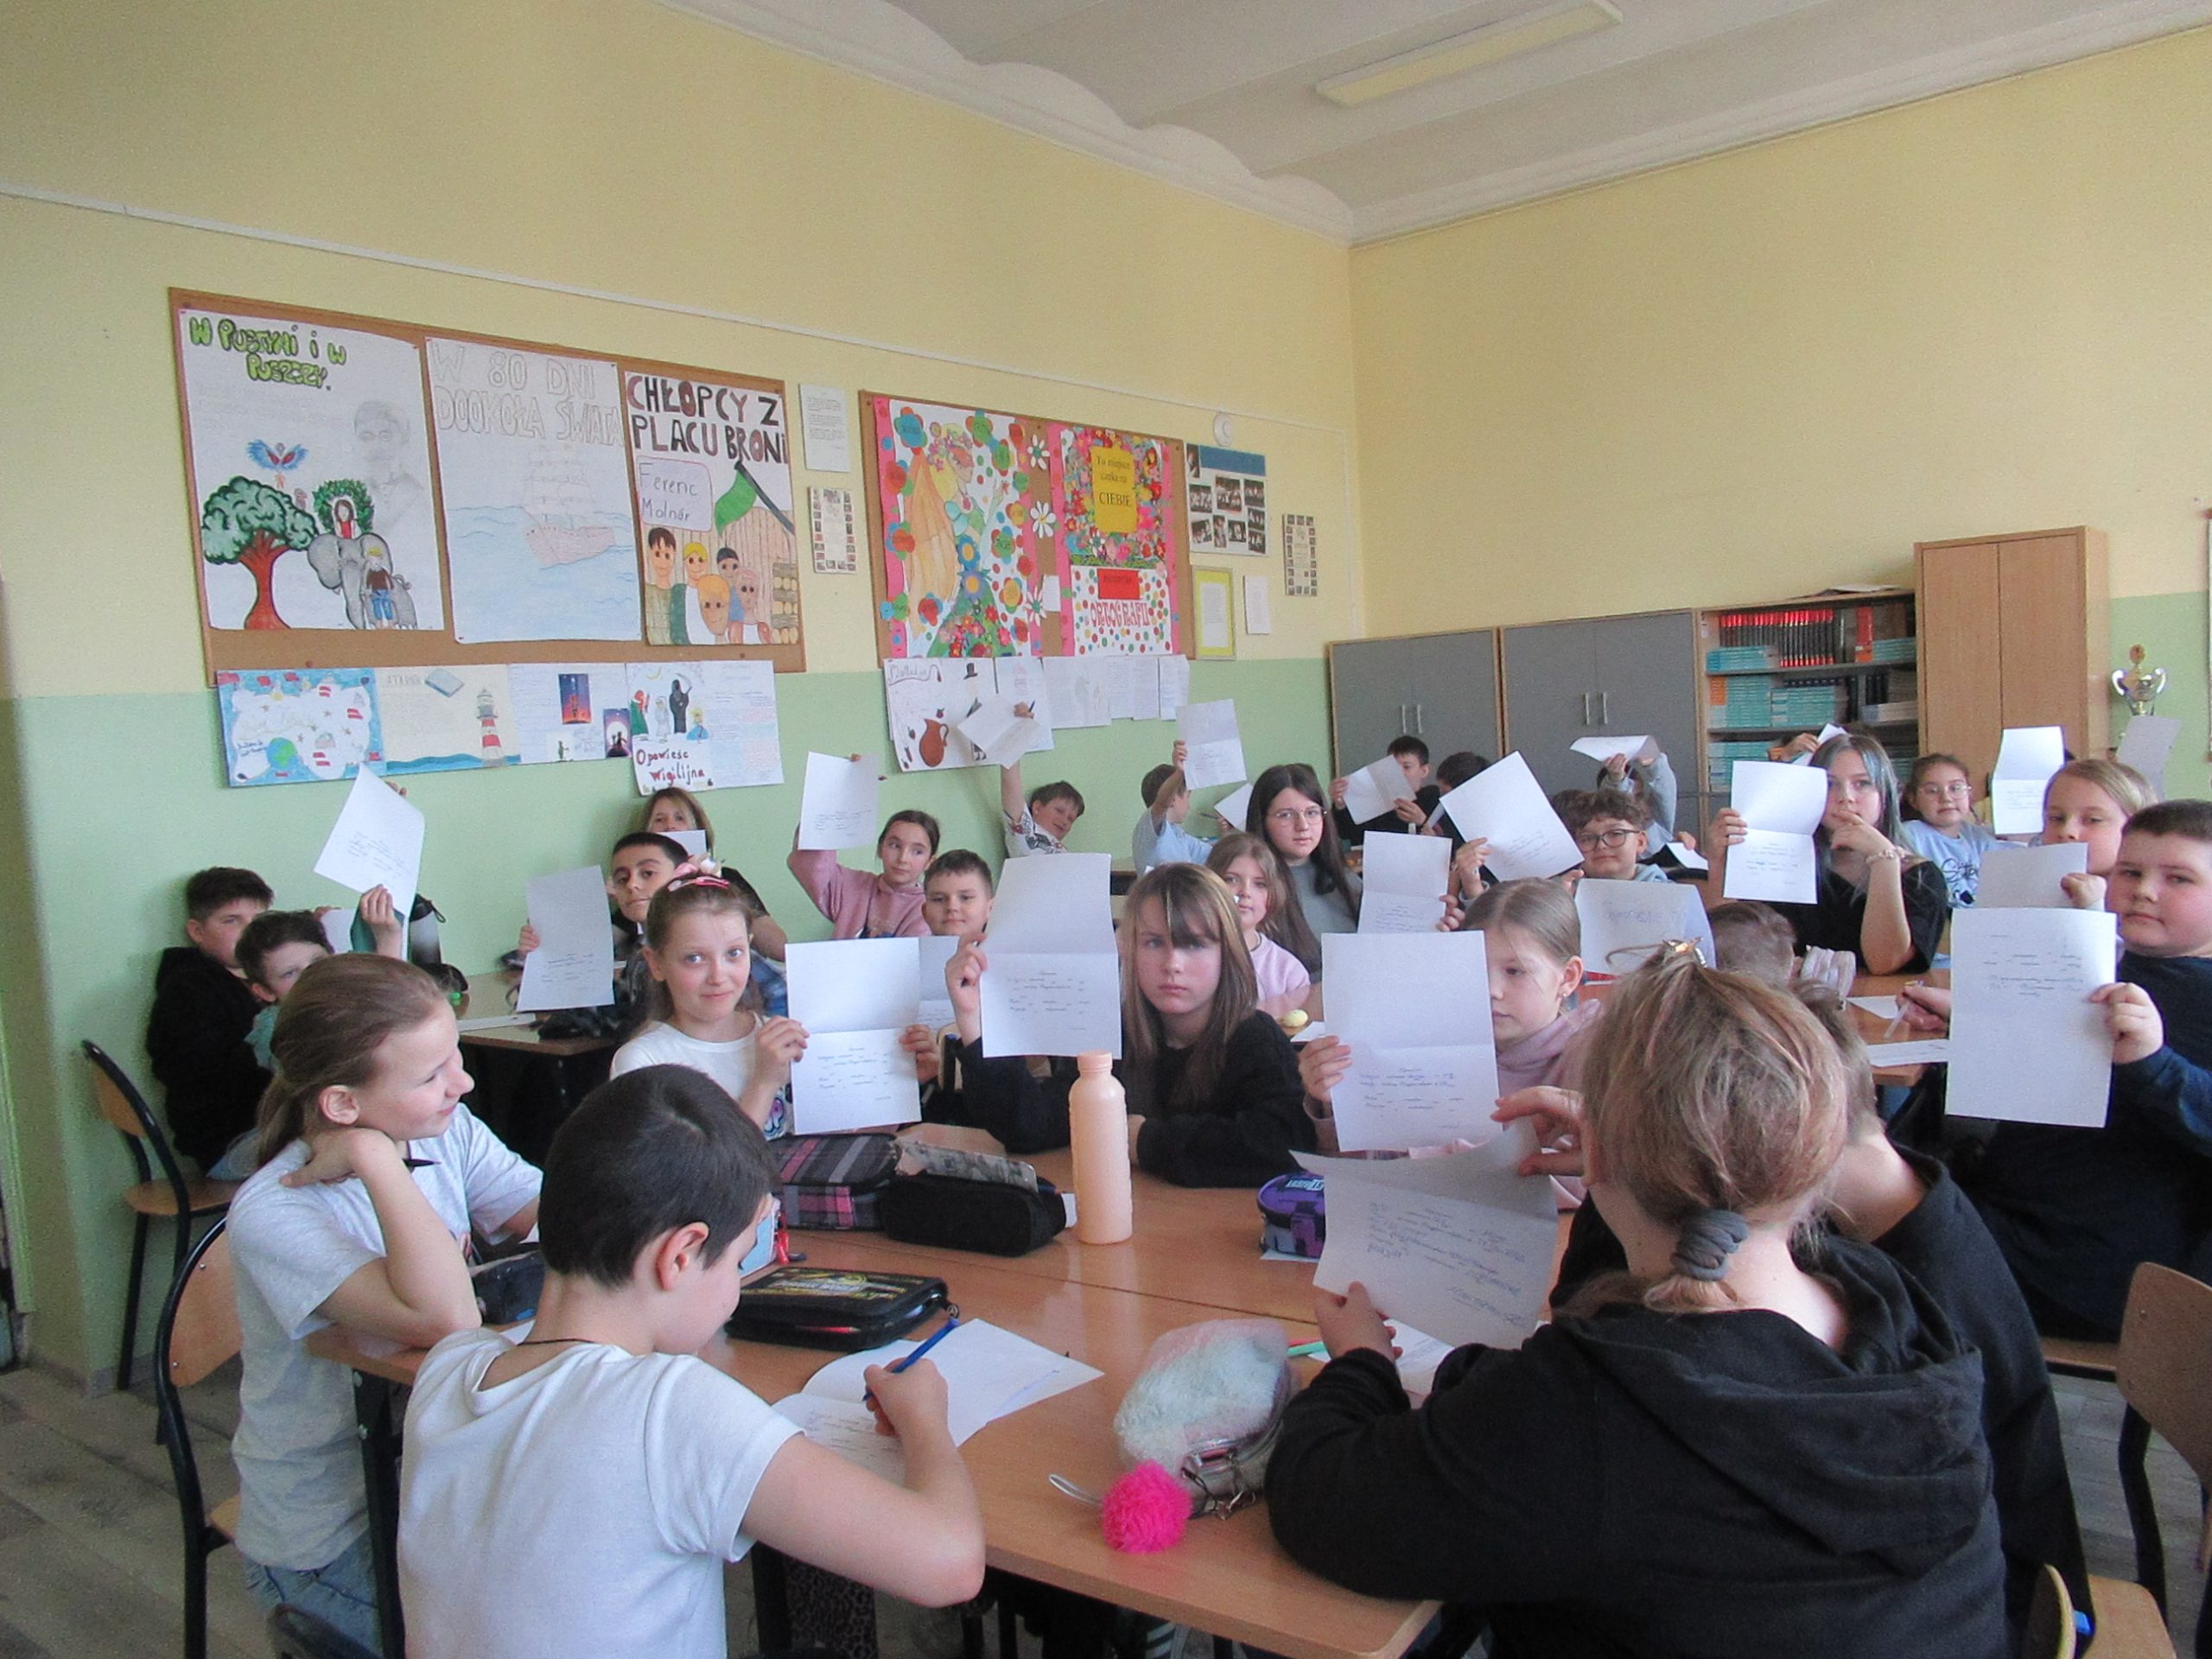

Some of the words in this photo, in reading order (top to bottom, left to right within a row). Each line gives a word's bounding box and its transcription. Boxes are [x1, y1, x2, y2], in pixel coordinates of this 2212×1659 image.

[189, 316, 213, 346] W
[435, 344, 466, 382] W
[487, 351, 527, 391] 80
[546, 358, 596, 400] DNI
[434, 385, 546, 440] DOOKOŁA
[626, 375, 748, 423] CHŁOPCY
[757, 395, 780, 427] Z
[631, 414, 719, 457] PLACU
[639, 461, 699, 497] Ferenc
[641, 496, 692, 522] Molnár
[1098, 492, 1132, 507] CIEBIE
